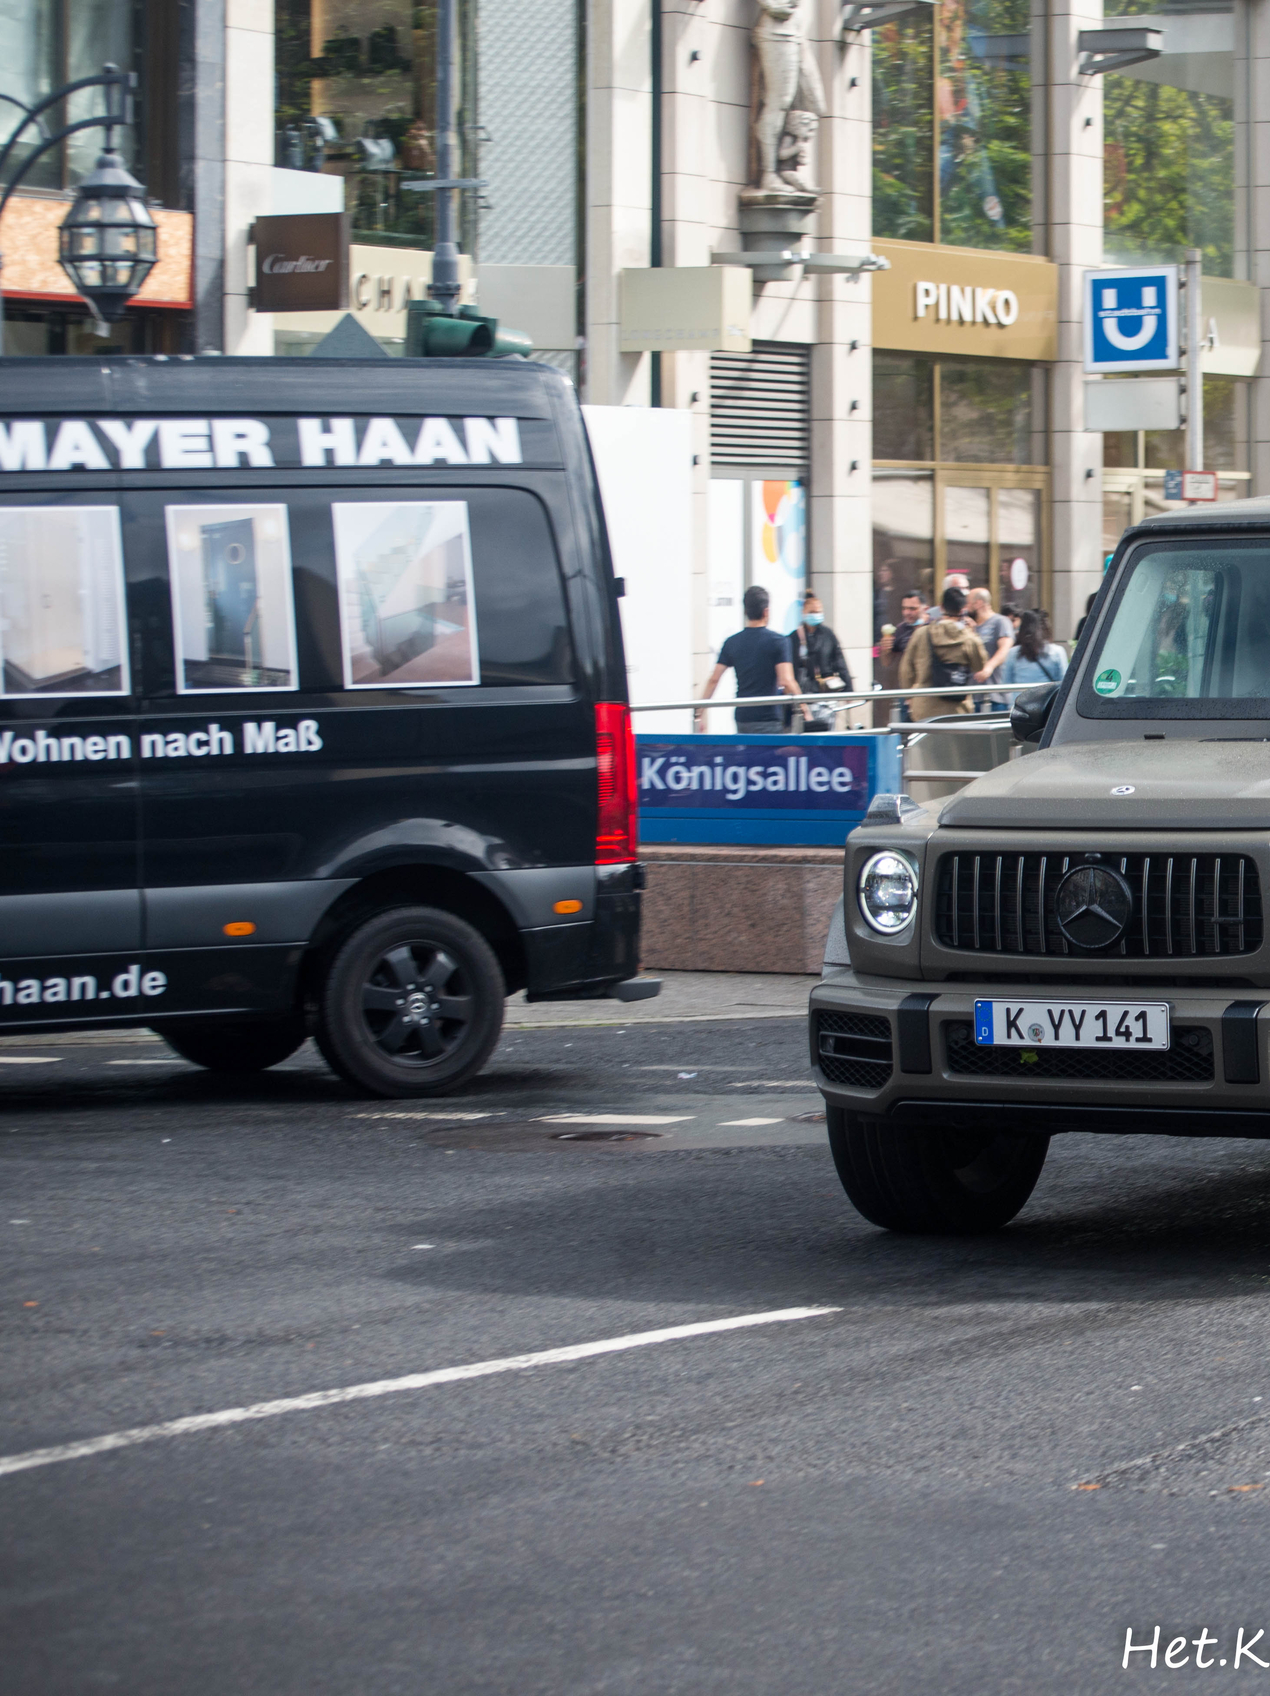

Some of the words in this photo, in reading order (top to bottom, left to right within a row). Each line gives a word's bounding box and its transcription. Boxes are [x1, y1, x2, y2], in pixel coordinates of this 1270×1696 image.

[262, 253, 334, 274] Cartier
[916, 281, 1019, 326] PINKO
[0, 418, 276, 471] MAYER
[298, 417, 523, 466] HAAN
[140, 723, 234, 758] nach
[243, 719, 323, 754] Maß
[641, 756, 853, 801] Königsallee
[982, 1027, 989, 1037] D
[1006, 1007, 1025, 1040] K
[1047, 1008, 1087, 1041] YY
[1094, 1009, 1153, 1043] 141
